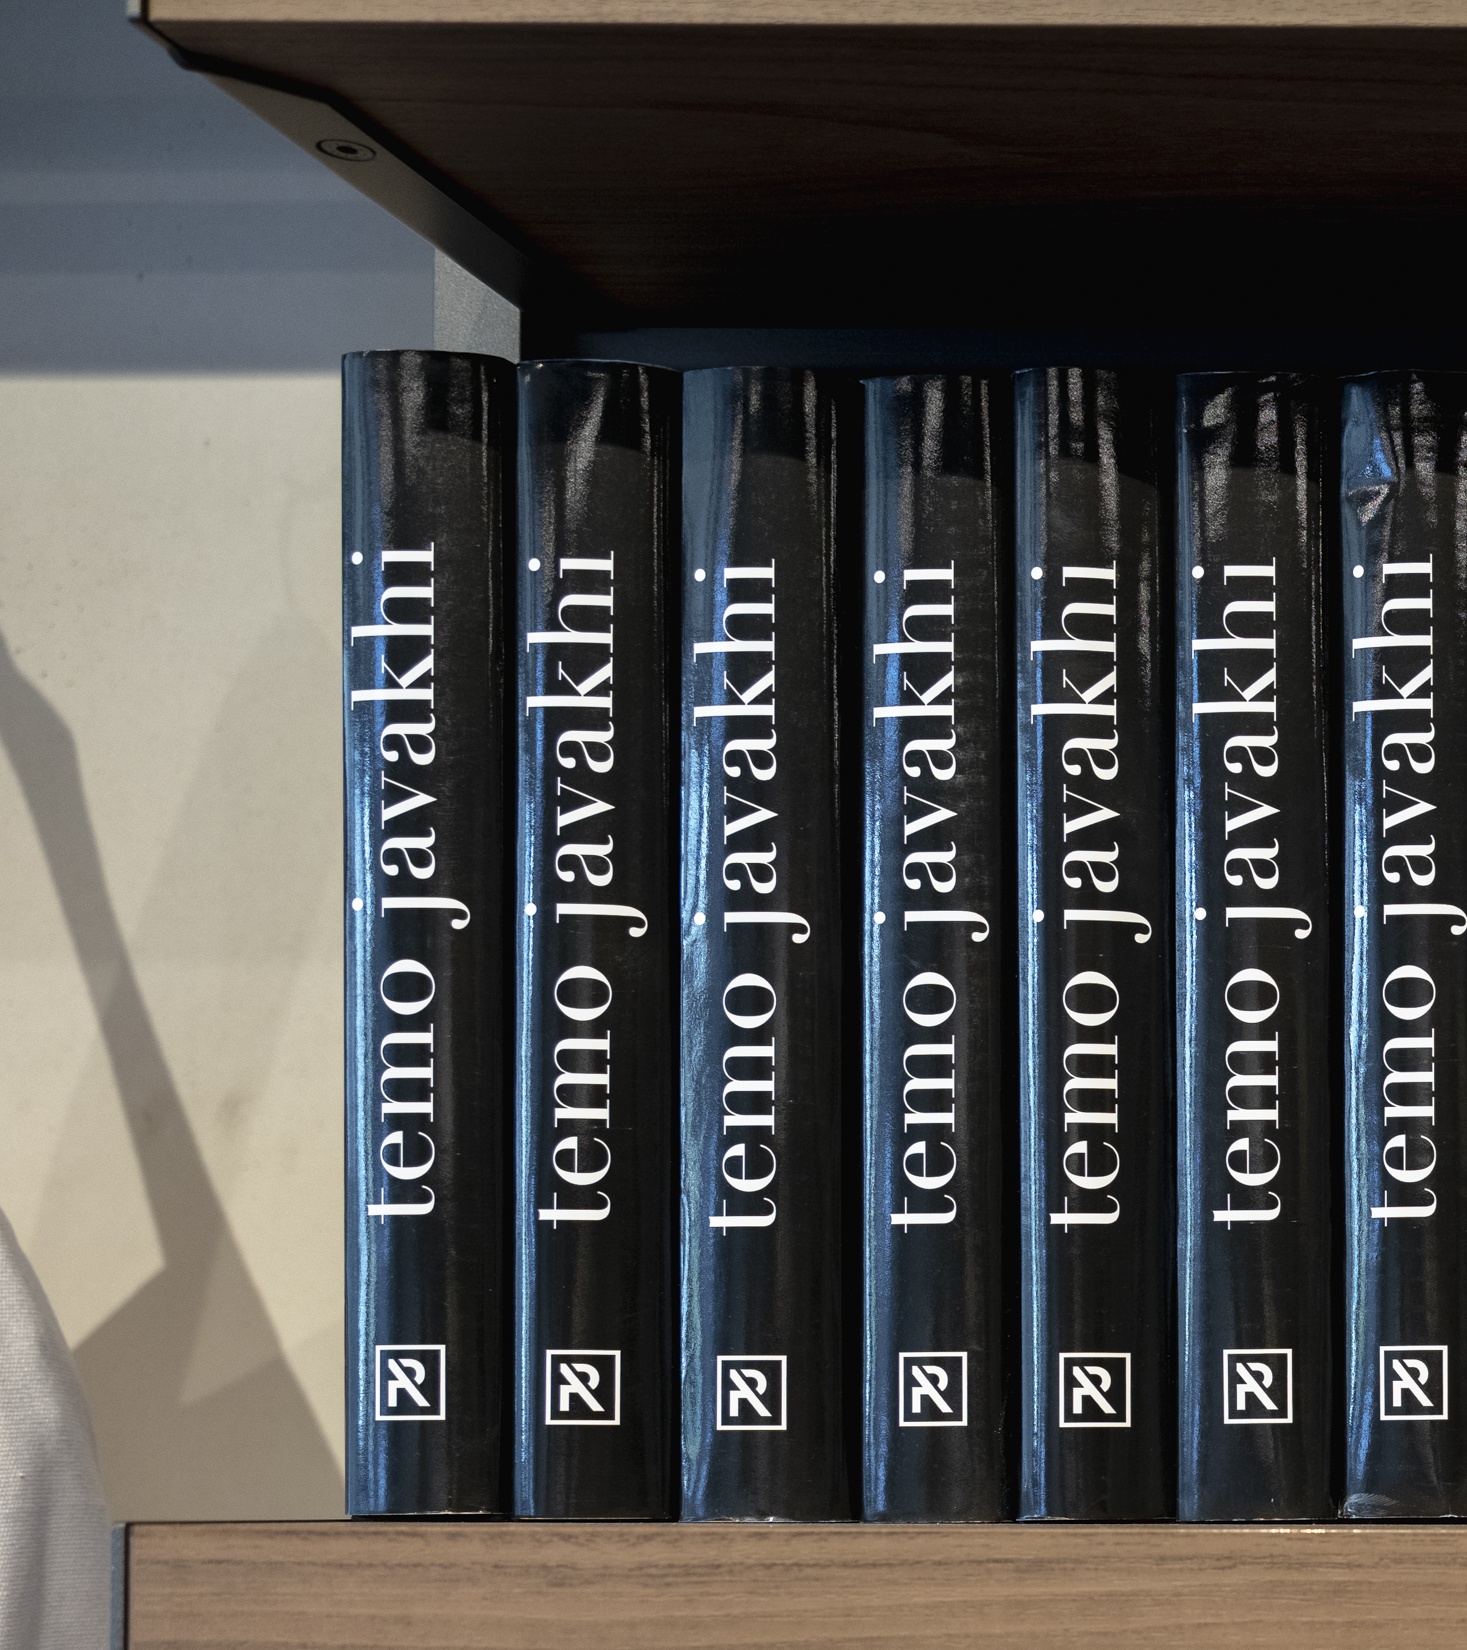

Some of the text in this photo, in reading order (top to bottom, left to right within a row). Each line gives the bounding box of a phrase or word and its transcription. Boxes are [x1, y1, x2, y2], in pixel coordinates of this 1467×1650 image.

[350, 541, 471, 1225] temo javakhi
[525, 550, 648, 1230] temo javakhi
[692, 558, 811, 1237] temo javakhi
[872, 559, 990, 1234] temo javakhi
[1030, 560, 1152, 1234] temo javakhi
[1191, 556, 1313, 1231] temo javakhi
[1370, 964, 1437, 1227] temo
